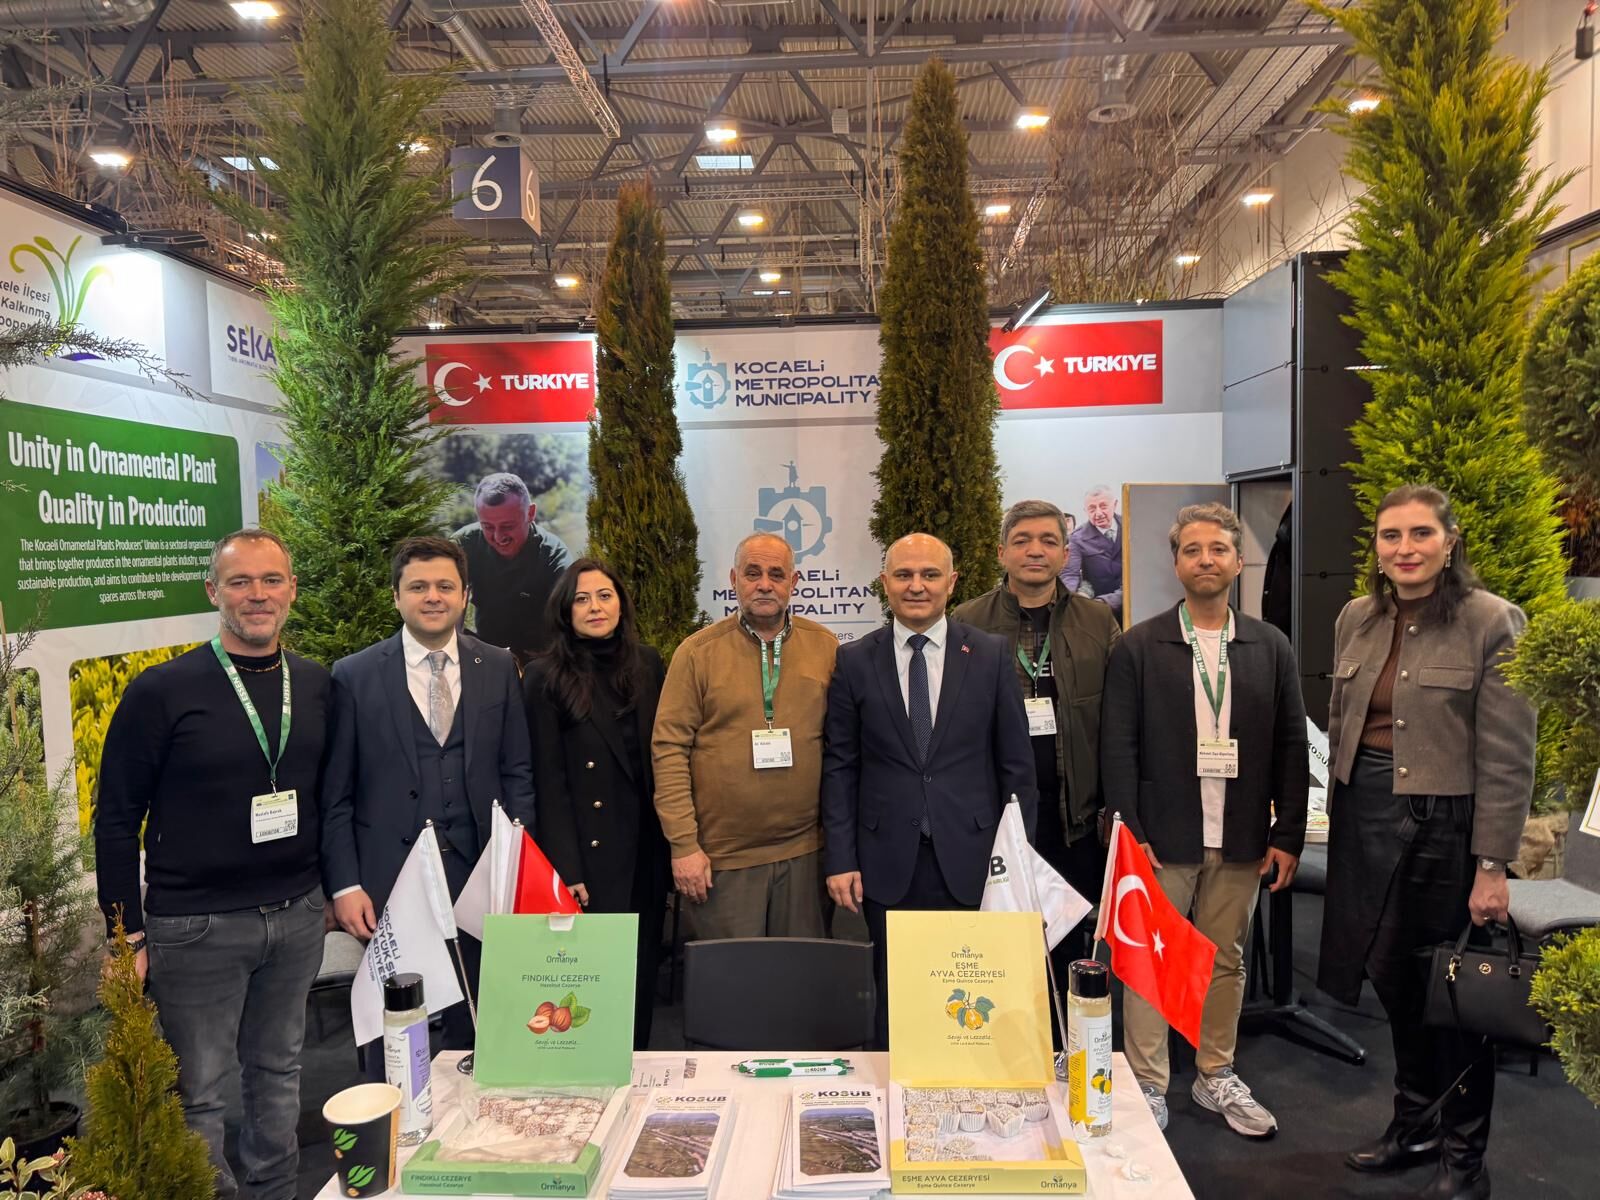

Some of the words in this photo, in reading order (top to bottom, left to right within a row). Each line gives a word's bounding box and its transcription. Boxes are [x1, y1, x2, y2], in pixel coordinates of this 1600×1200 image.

[471, 154, 503, 212] 6
[525, 169, 536, 221] 6
[735, 375, 881, 391] METROPOLITA
[735, 390, 872, 407] MUNICIPALITY
[8, 431, 62, 475] Unity
[66, 438, 85, 473] in
[88, 441, 181, 482] Ornamental
[182, 453, 218, 485] Plant
[38, 489, 104, 530] Quality
[108, 495, 125, 526] in
[128, 495, 207, 527] Production
[20, 538, 34, 551] The
[34, 538, 59, 551] Kocaeli
[59, 538, 96, 551] Ornamental
[96, 538, 115, 551] Plants
[143, 539, 160, 550] Union
[19, 557, 34, 571] that
[34, 556, 57, 572] brings
[57, 556, 85, 572] together
[85, 555, 115, 571] producers
[115, 555, 121, 568] in
[121, 555, 132, 568] the
[132, 554, 162, 568] ornamental
[162, 554, 179, 568] plants
[17, 576, 58, 591] sustainable
[57, 575, 94, 590] production,
[93, 574, 106, 586] and
[106, 573, 120, 585] aims
[120, 573, 128, 585] to
[128, 572, 155, 584] contribute
[155, 571, 162, 583] to
[161, 571, 172, 582] the
[171, 570, 201, 583] development
[99, 592, 119, 605] spaces
[119, 590, 137, 602] across
[136, 589, 147, 600] the
[546, 955, 578, 965] Ormanya
[951, 951, 984, 960] Ormanya
[930, 970, 955, 978] AYVA
[955, 962, 979, 970] EŞME
[521, 974, 559, 982] FINDIKLI
[560, 974, 601, 982] CEZERYE
[540, 1182, 576, 1192] Ormanya
[1040, 1180, 1077, 1189] Ormanya
